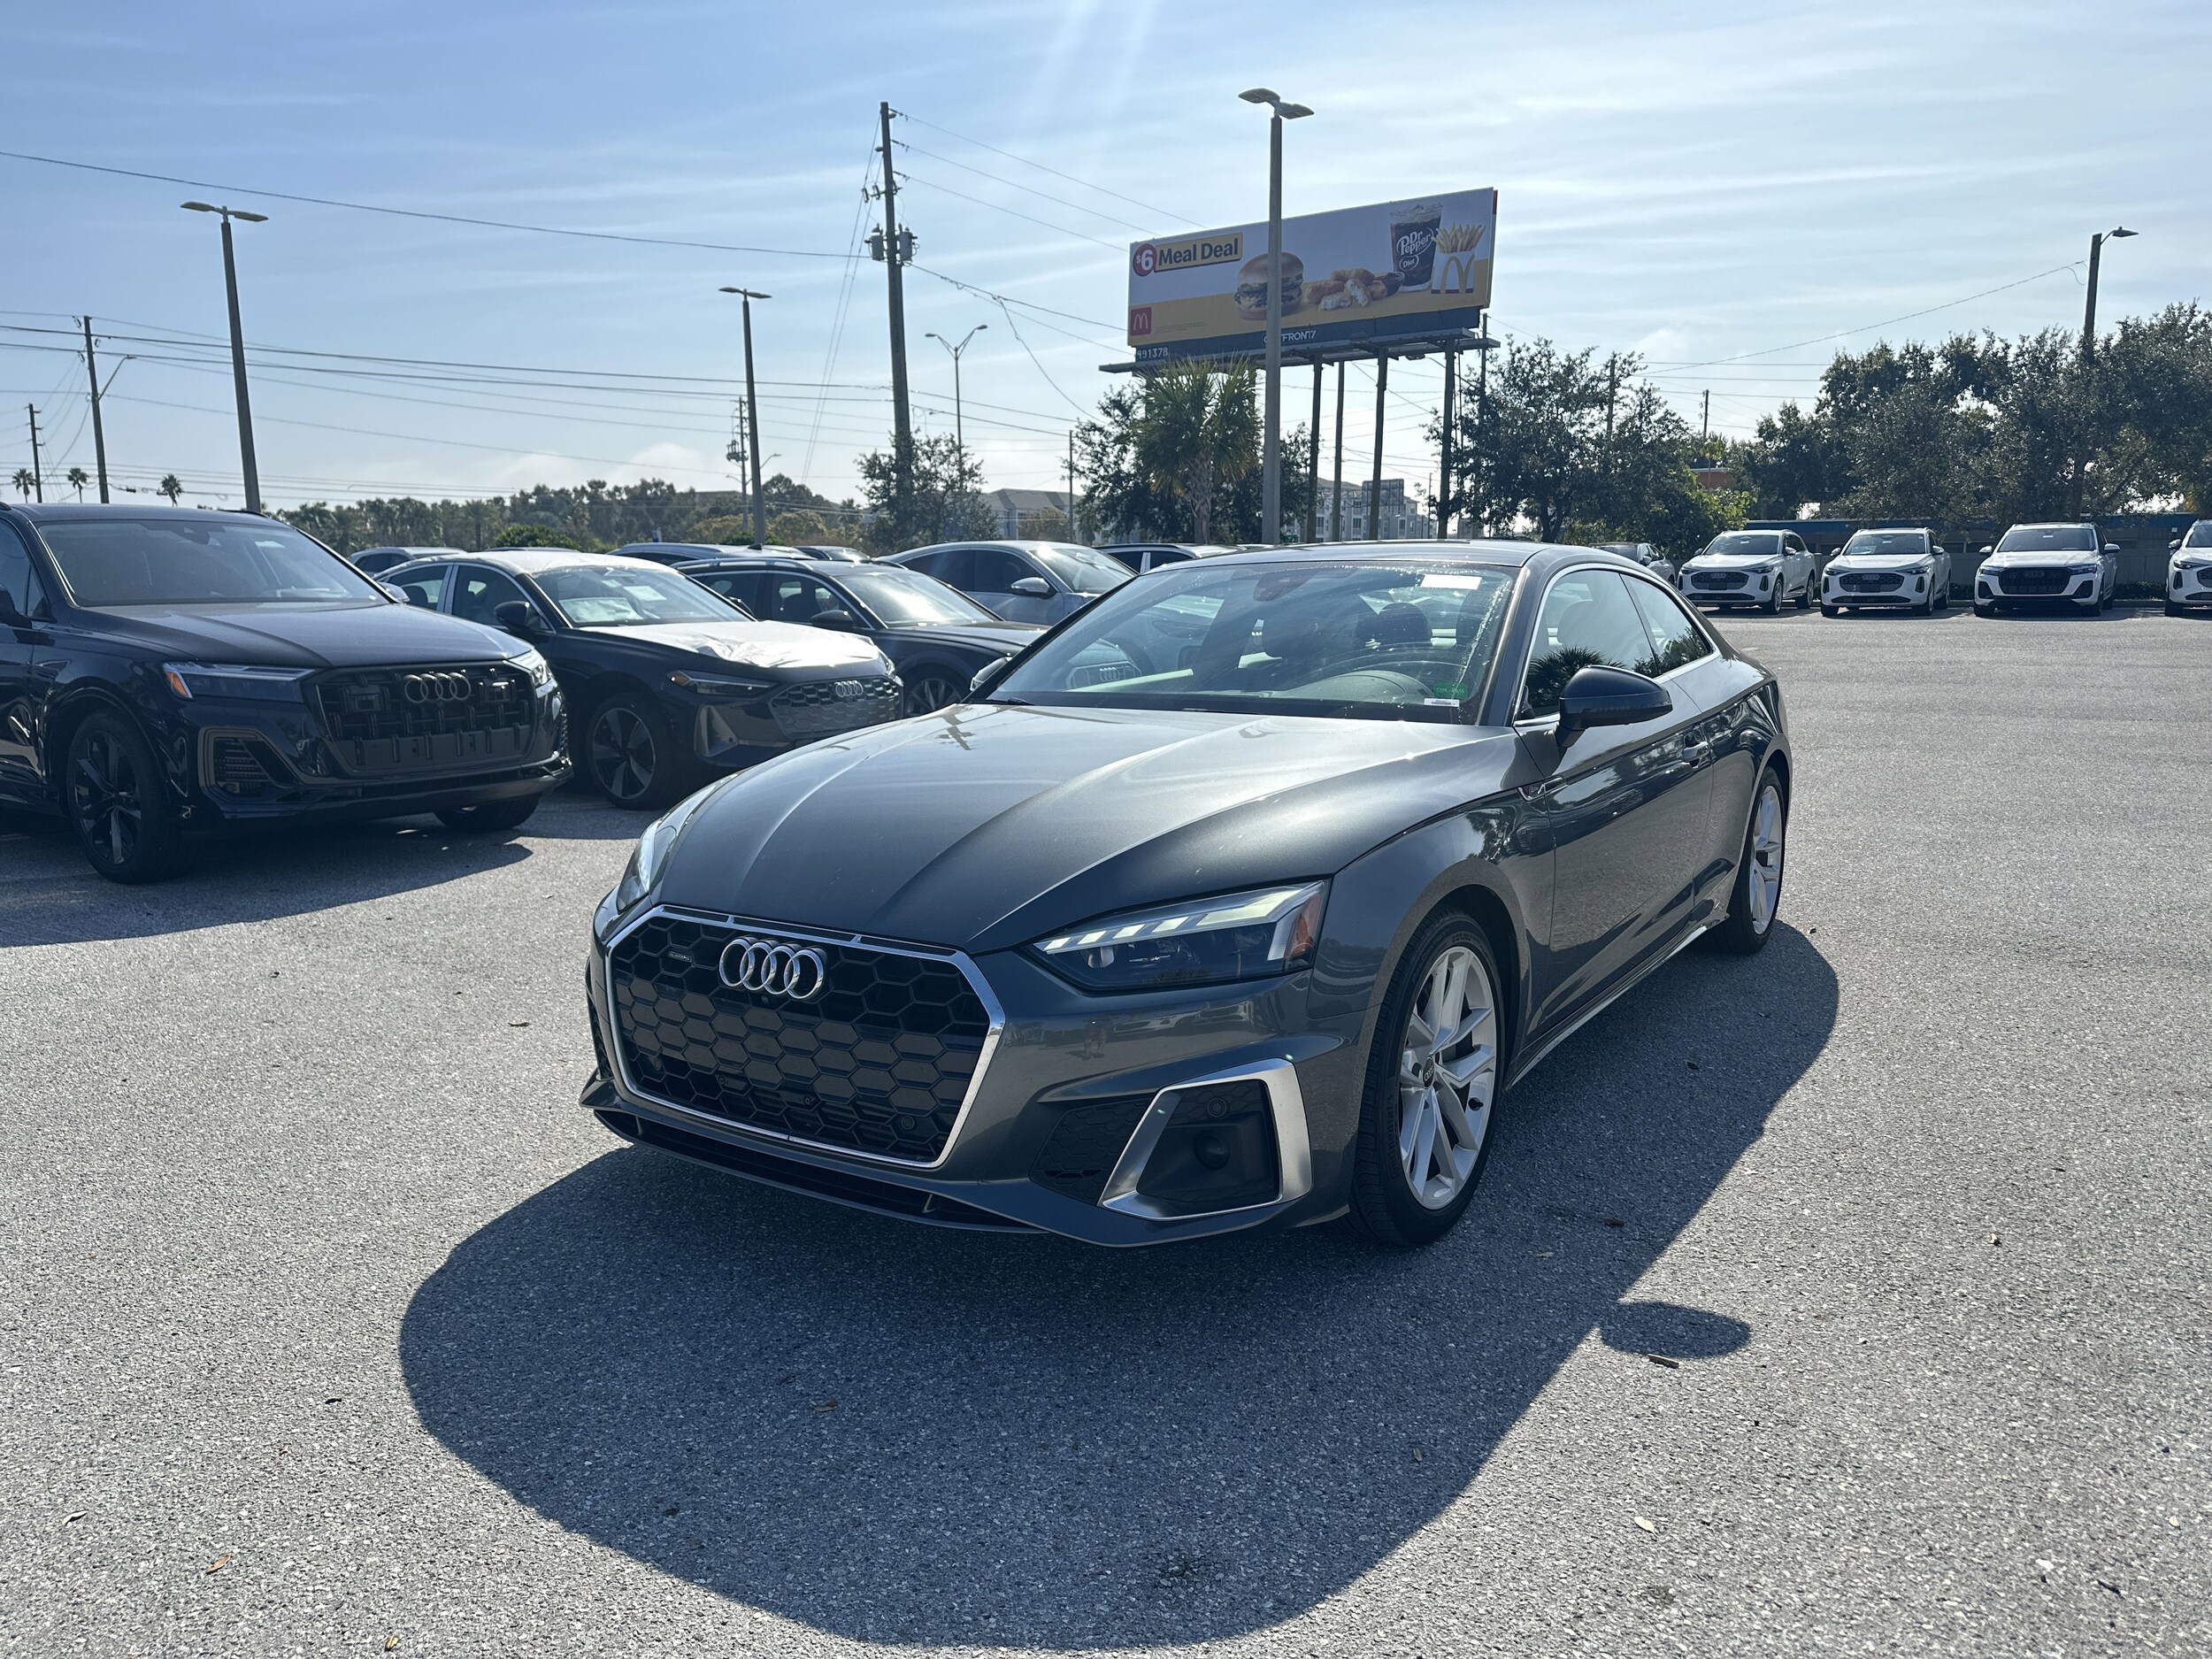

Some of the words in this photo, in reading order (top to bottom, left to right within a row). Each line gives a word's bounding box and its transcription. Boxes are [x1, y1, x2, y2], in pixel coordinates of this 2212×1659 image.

[1409, 231, 1424, 244] Dr
[1400, 233, 1432, 256] Pepper
[1135, 249, 1154, 271] $6
[1158, 243, 1197, 265] Meal
[1201, 237, 1239, 260] Deal
[1402, 257, 1416, 268] Diet
[1137, 347, 1169, 359] 49137B
